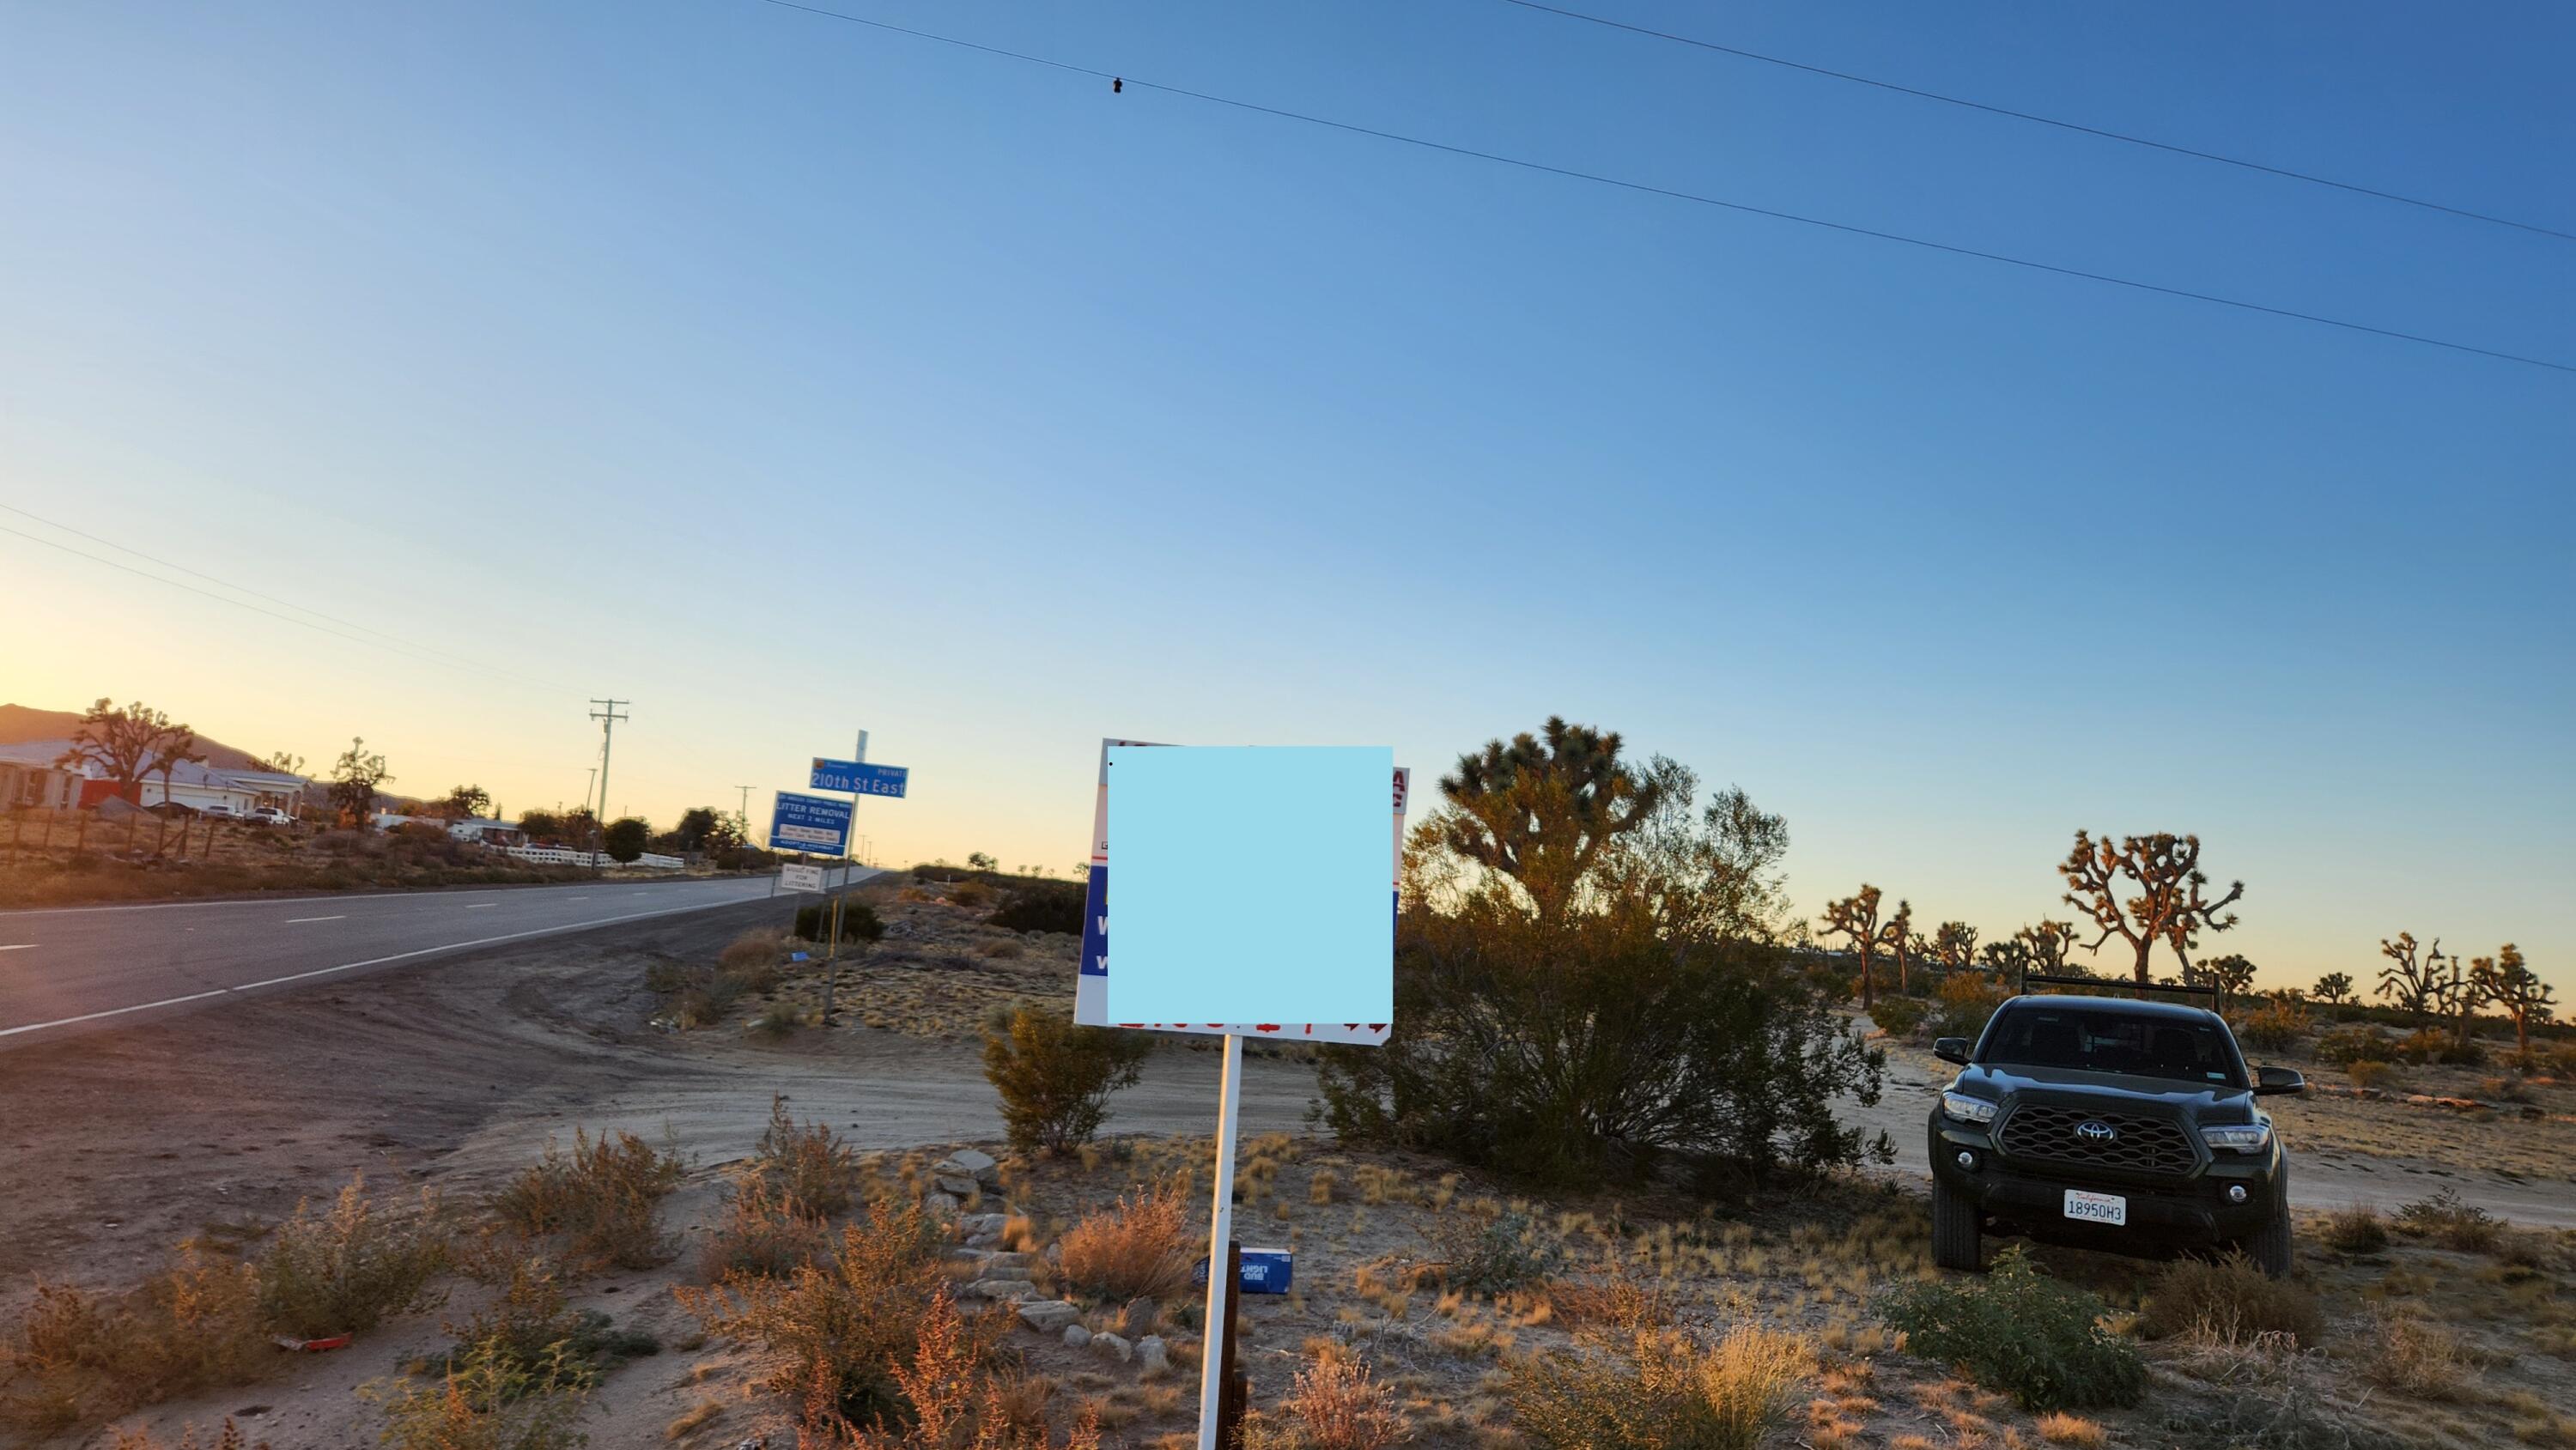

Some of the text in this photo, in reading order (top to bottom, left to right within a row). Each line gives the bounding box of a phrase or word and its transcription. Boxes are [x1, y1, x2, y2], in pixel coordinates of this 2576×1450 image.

[811, 773, 905, 794] 210th St East
[776, 802, 850, 819] LITTER REMOVAL
[2068, 1201, 2122, 1220] 18950H3
[1240, 1265, 1268, 1273] LIGHT
[1244, 1272, 1265, 1281] BUD
